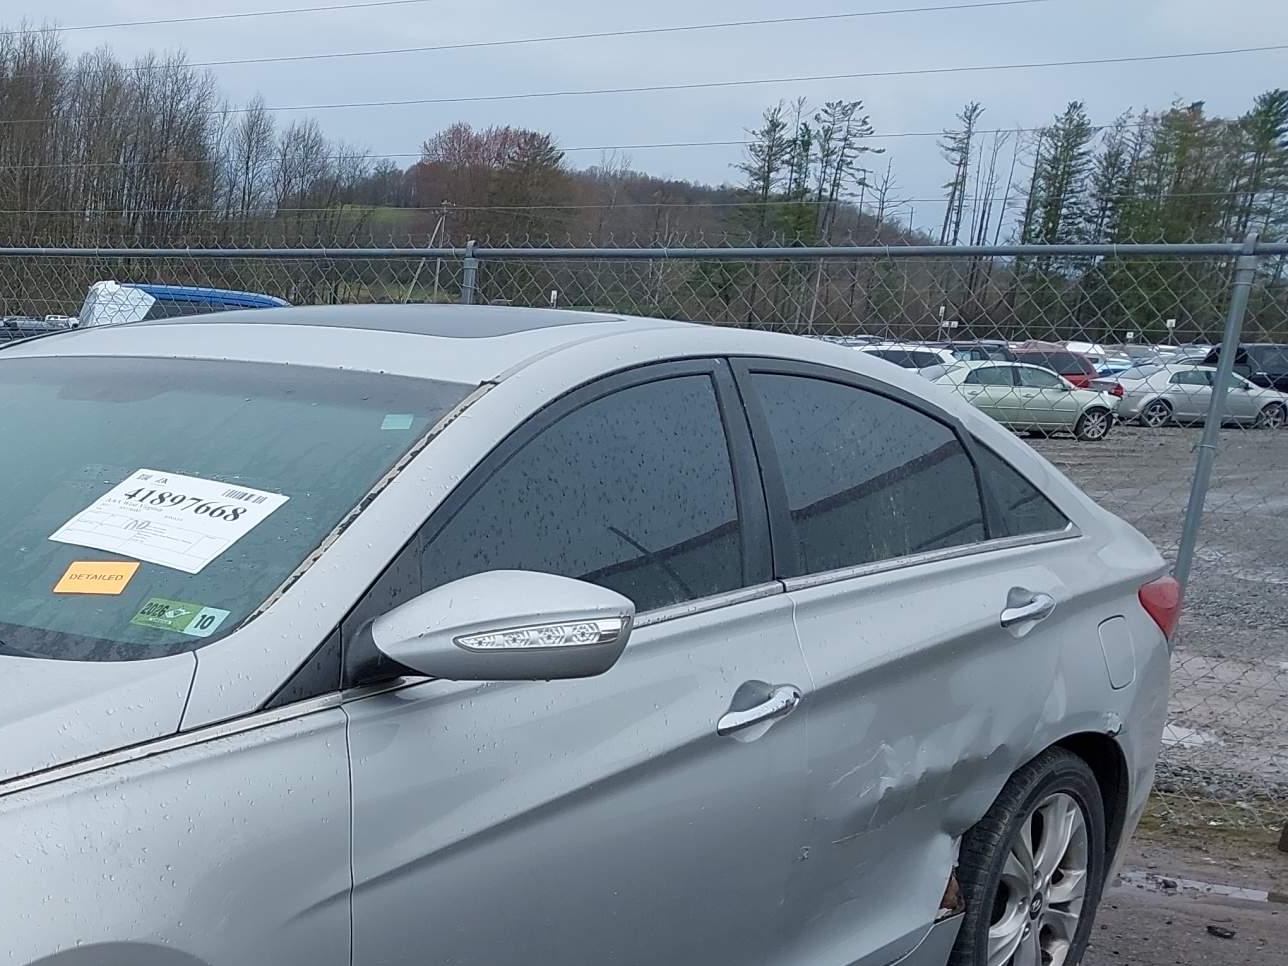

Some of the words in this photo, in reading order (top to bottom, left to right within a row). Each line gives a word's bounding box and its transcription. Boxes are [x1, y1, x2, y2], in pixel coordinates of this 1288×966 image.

[123, 487, 248, 522] 41897668
[68, 573, 124, 581] DETAILED
[193, 614, 216, 630] 10
